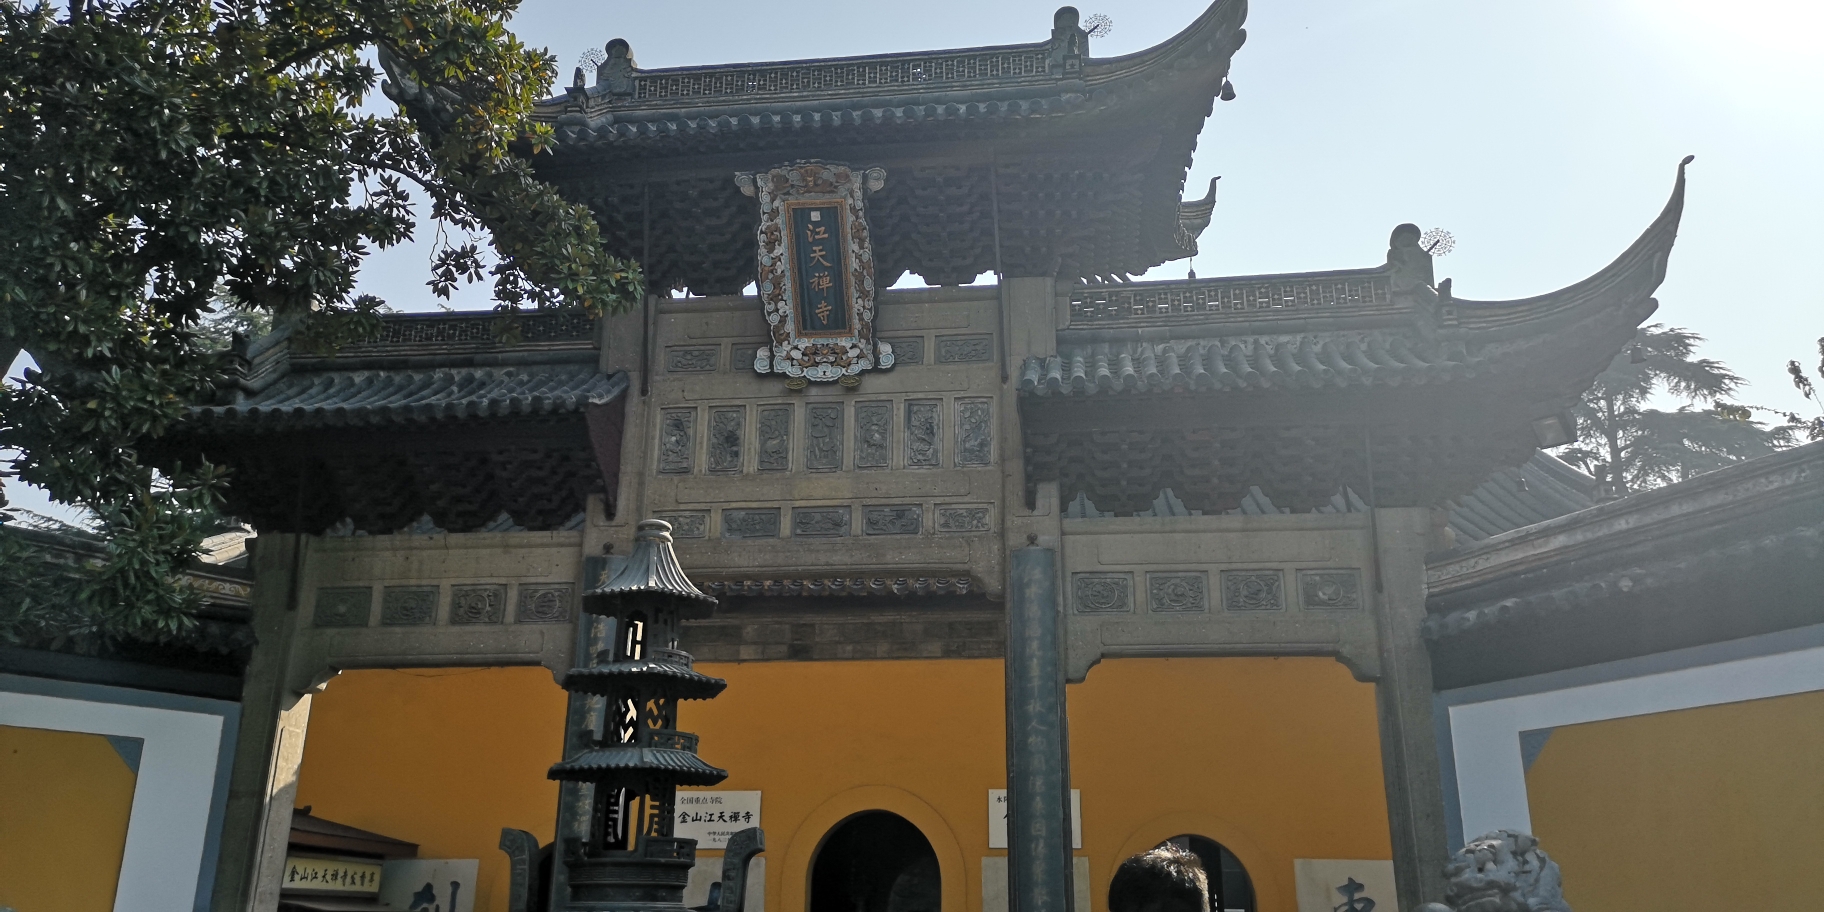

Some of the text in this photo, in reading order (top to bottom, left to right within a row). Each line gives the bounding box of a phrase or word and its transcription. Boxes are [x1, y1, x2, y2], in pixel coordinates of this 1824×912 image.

[680, 796, 723, 805] 全国重点寺院
